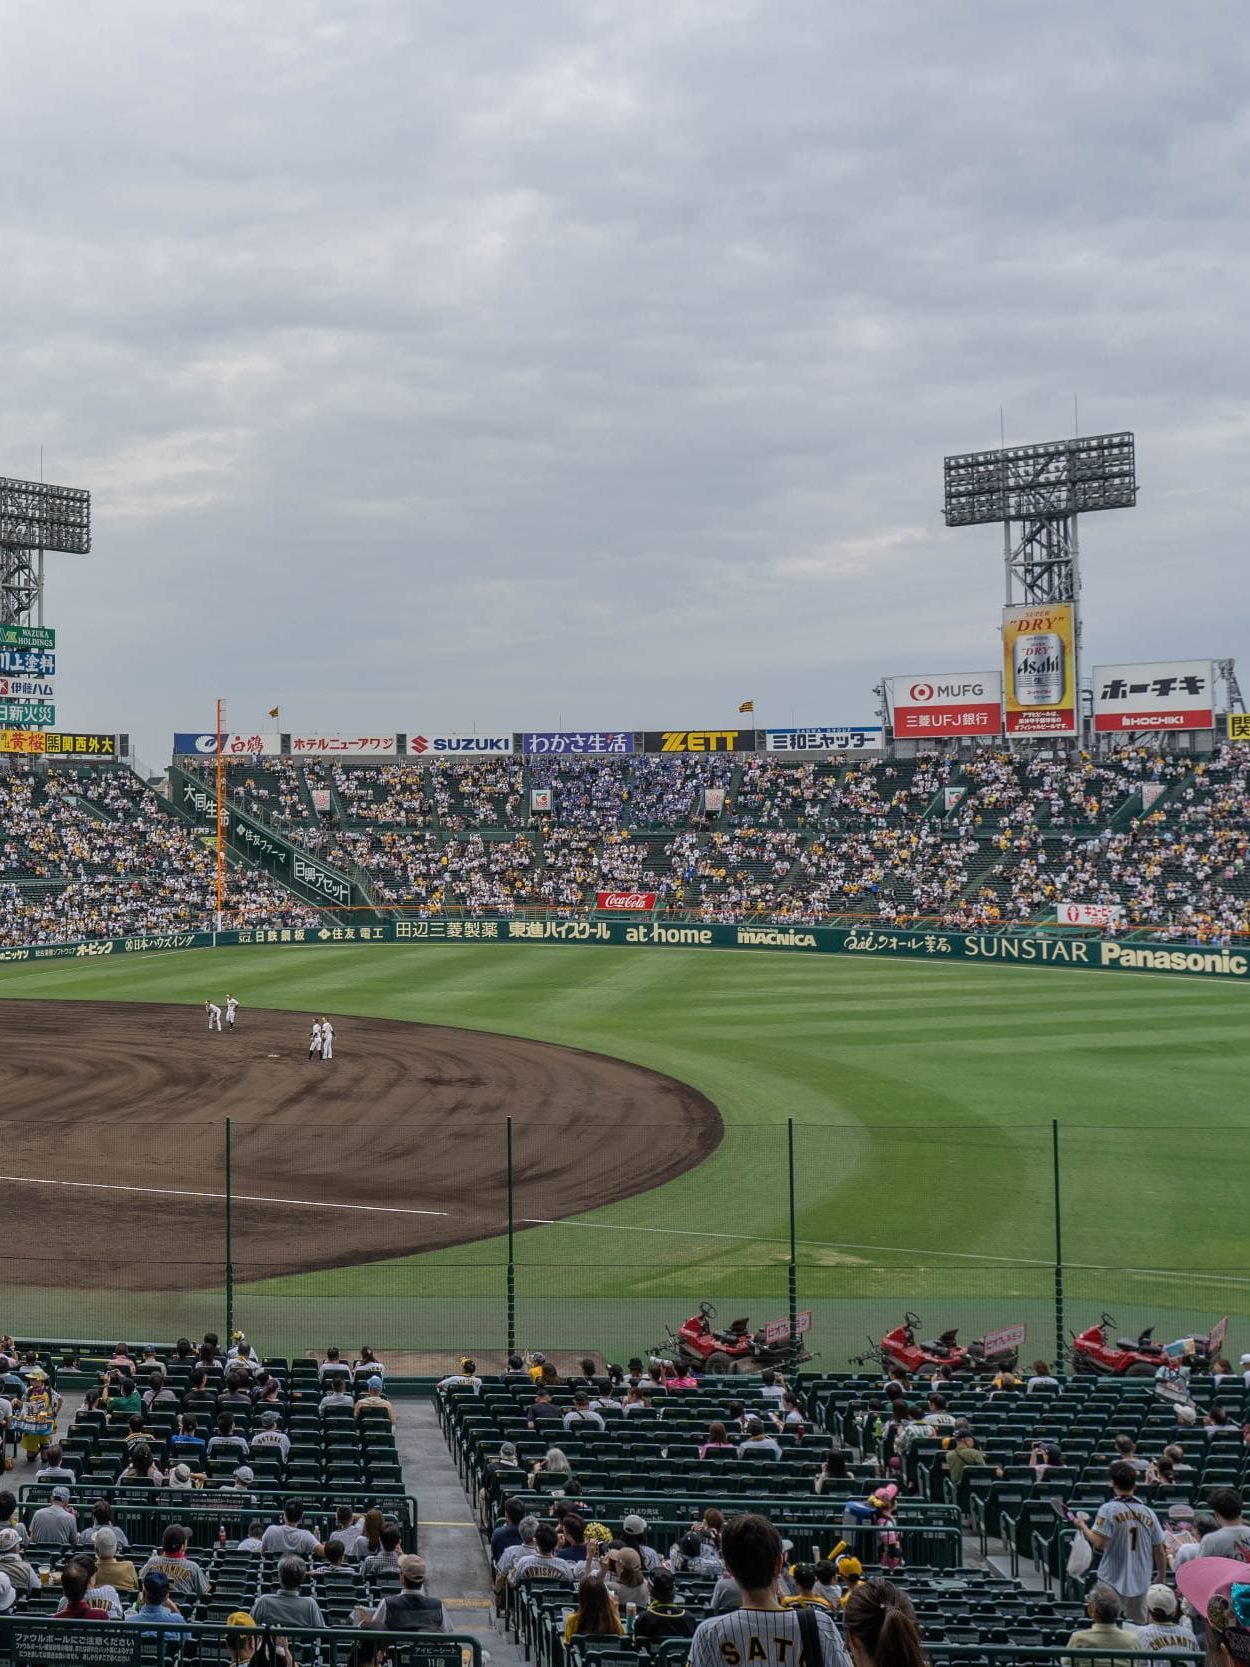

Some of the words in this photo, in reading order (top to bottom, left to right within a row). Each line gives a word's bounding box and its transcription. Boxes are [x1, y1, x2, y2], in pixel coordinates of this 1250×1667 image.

[21, 628, 49, 637] WAZUKA
[18, 638, 53, 647] HOLDINGS
[1017, 655, 1059, 675] Asahi
[10, 681, 54, 696] 伊藤ハム
[937, 684, 984, 698] MUFG
[1101, 675, 1206, 701] ホーチキ
[906, 712, 989, 728] 三菱UFJ銀行
[1130, 715, 1184, 726] HOCHIKI
[11, 732, 45, 751] 黄桜
[62, 736, 113, 753] 関西外大
[230, 735, 264, 756] 白鶴
[293, 737, 393, 751] ホテルニューアワジ
[433, 738, 510, 751] SUZUKI
[528, 734, 628, 752] わかさ生活
[661, 731, 739, 752] ZETT
[183, 784, 230, 828] 大同生命
[245, 829, 286, 864] 住友ファーマ
[295, 862, 348, 901] 日興アセット
[332, 926, 384, 940] 住友電工
[395, 921, 498, 939] 田辺三菱製薬
[508, 921, 611, 940] 東進ハイスクール
[625, 925, 648, 943] at
[652, 922, 712, 944] home
[76, 941, 113, 957] オービック
[964, 936, 1089, 962] SUNSTAR
[1101, 942, 1248, 975] Panasonic
[1129, 1526, 1137, 1551] 1
[14, 1633, 135, 1647] ファウルボールにご注意ください
